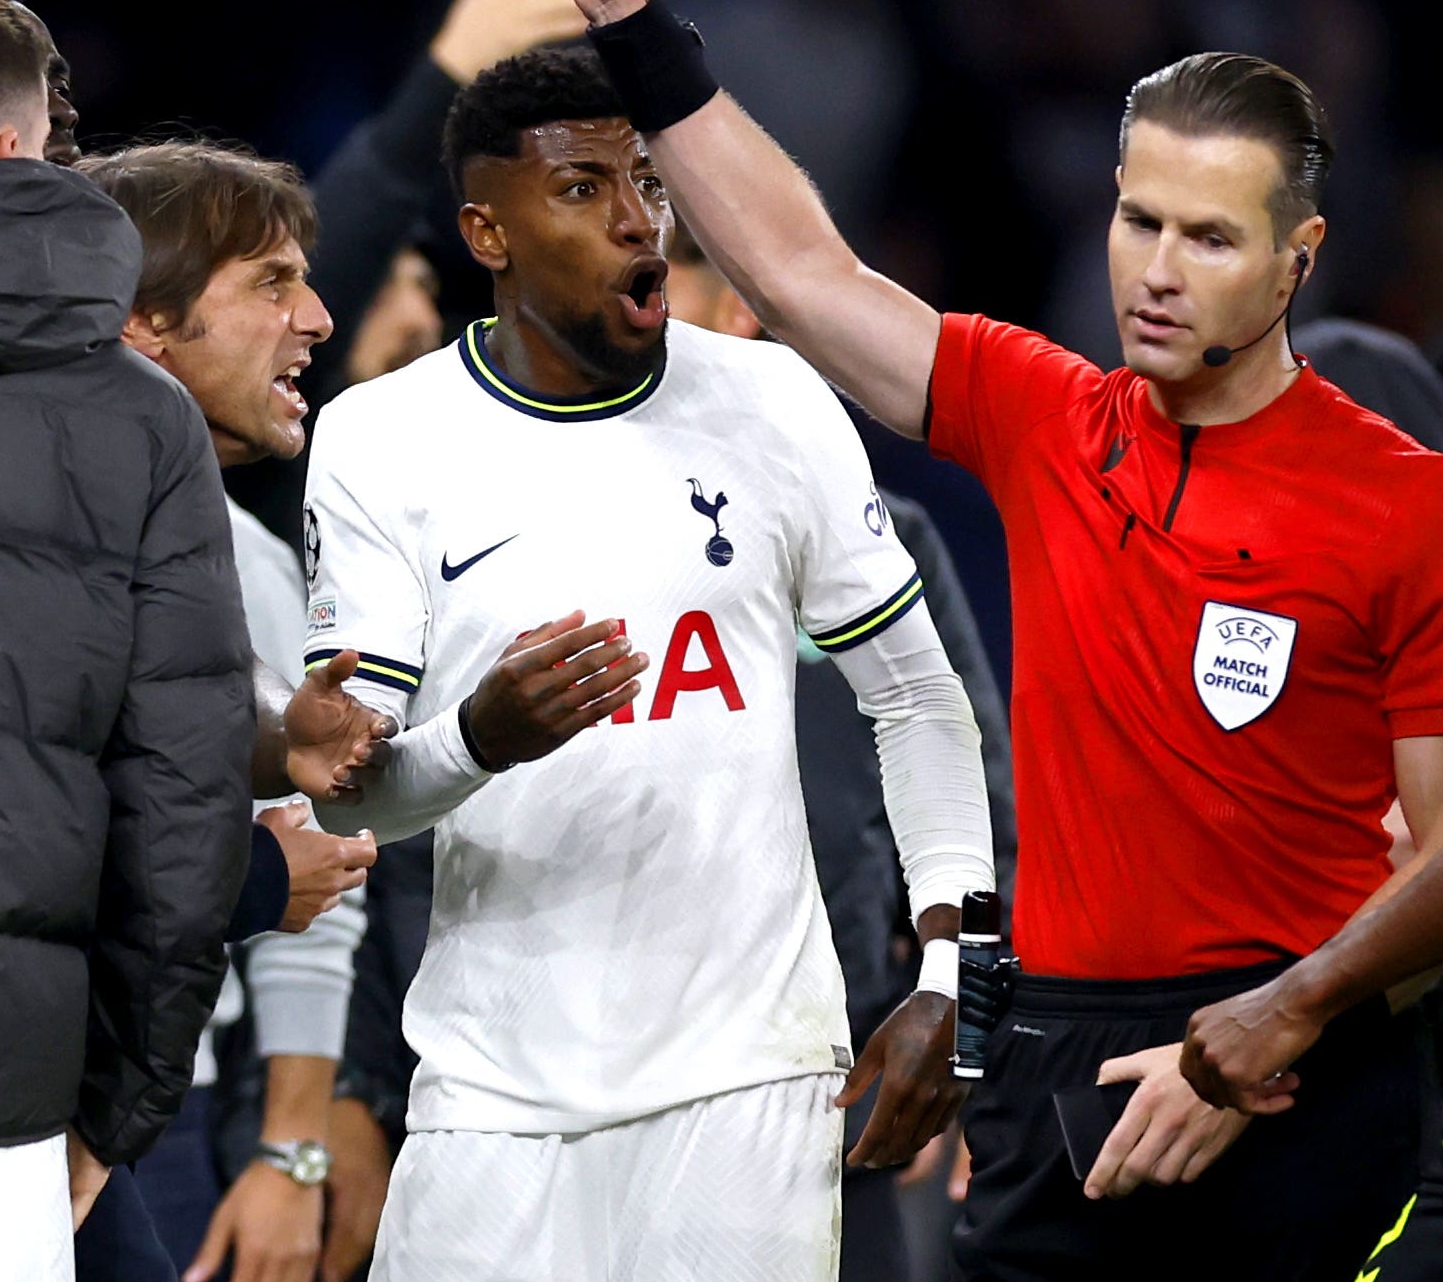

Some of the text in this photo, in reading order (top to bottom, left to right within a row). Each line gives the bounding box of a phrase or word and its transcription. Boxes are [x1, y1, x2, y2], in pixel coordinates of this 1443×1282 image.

[1218, 621, 1272, 650] UEFA
[1213, 655, 1268, 678] MATCH
[1203, 672, 1270, 698] OFFICIAL
